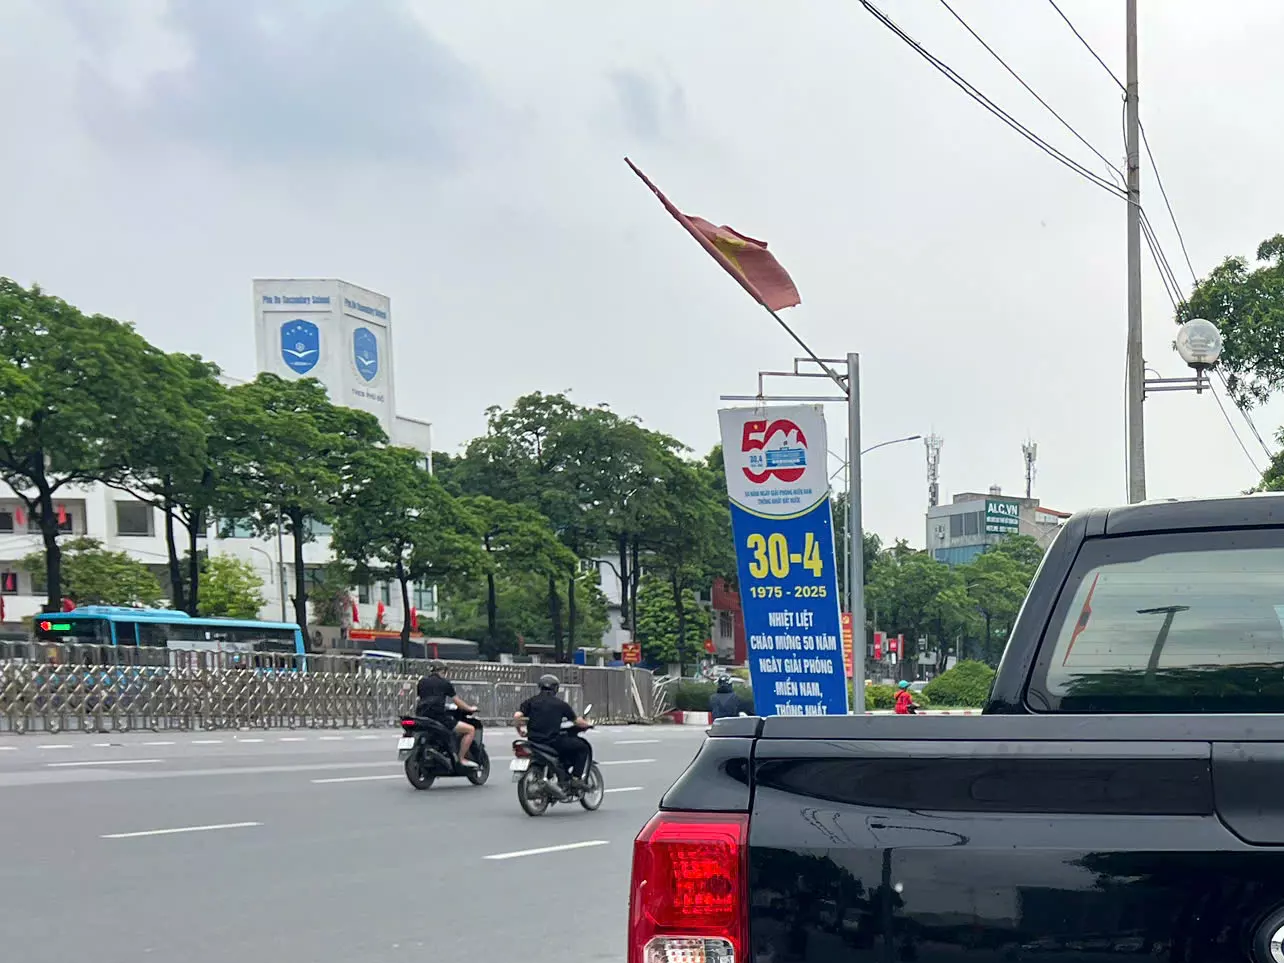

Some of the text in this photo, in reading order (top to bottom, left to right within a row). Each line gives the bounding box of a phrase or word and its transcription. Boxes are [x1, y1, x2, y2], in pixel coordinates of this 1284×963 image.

[988, 503, 1018, 515] ALC.VN
[747, 532, 823, 579] 30-4
[750, 586, 782, 598] 1975
[794, 585, 827, 598] 2025
[768, 609, 813, 630] NHIỆT LIỆT
[750, 632, 774, 650] CHÀO
[775, 632, 802, 650] MỪNG
[803, 636, 814, 651] 50
[815, 633, 837, 651] NĂM
[759, 653, 833, 674] NGÀY GIẢI PHÓNG
